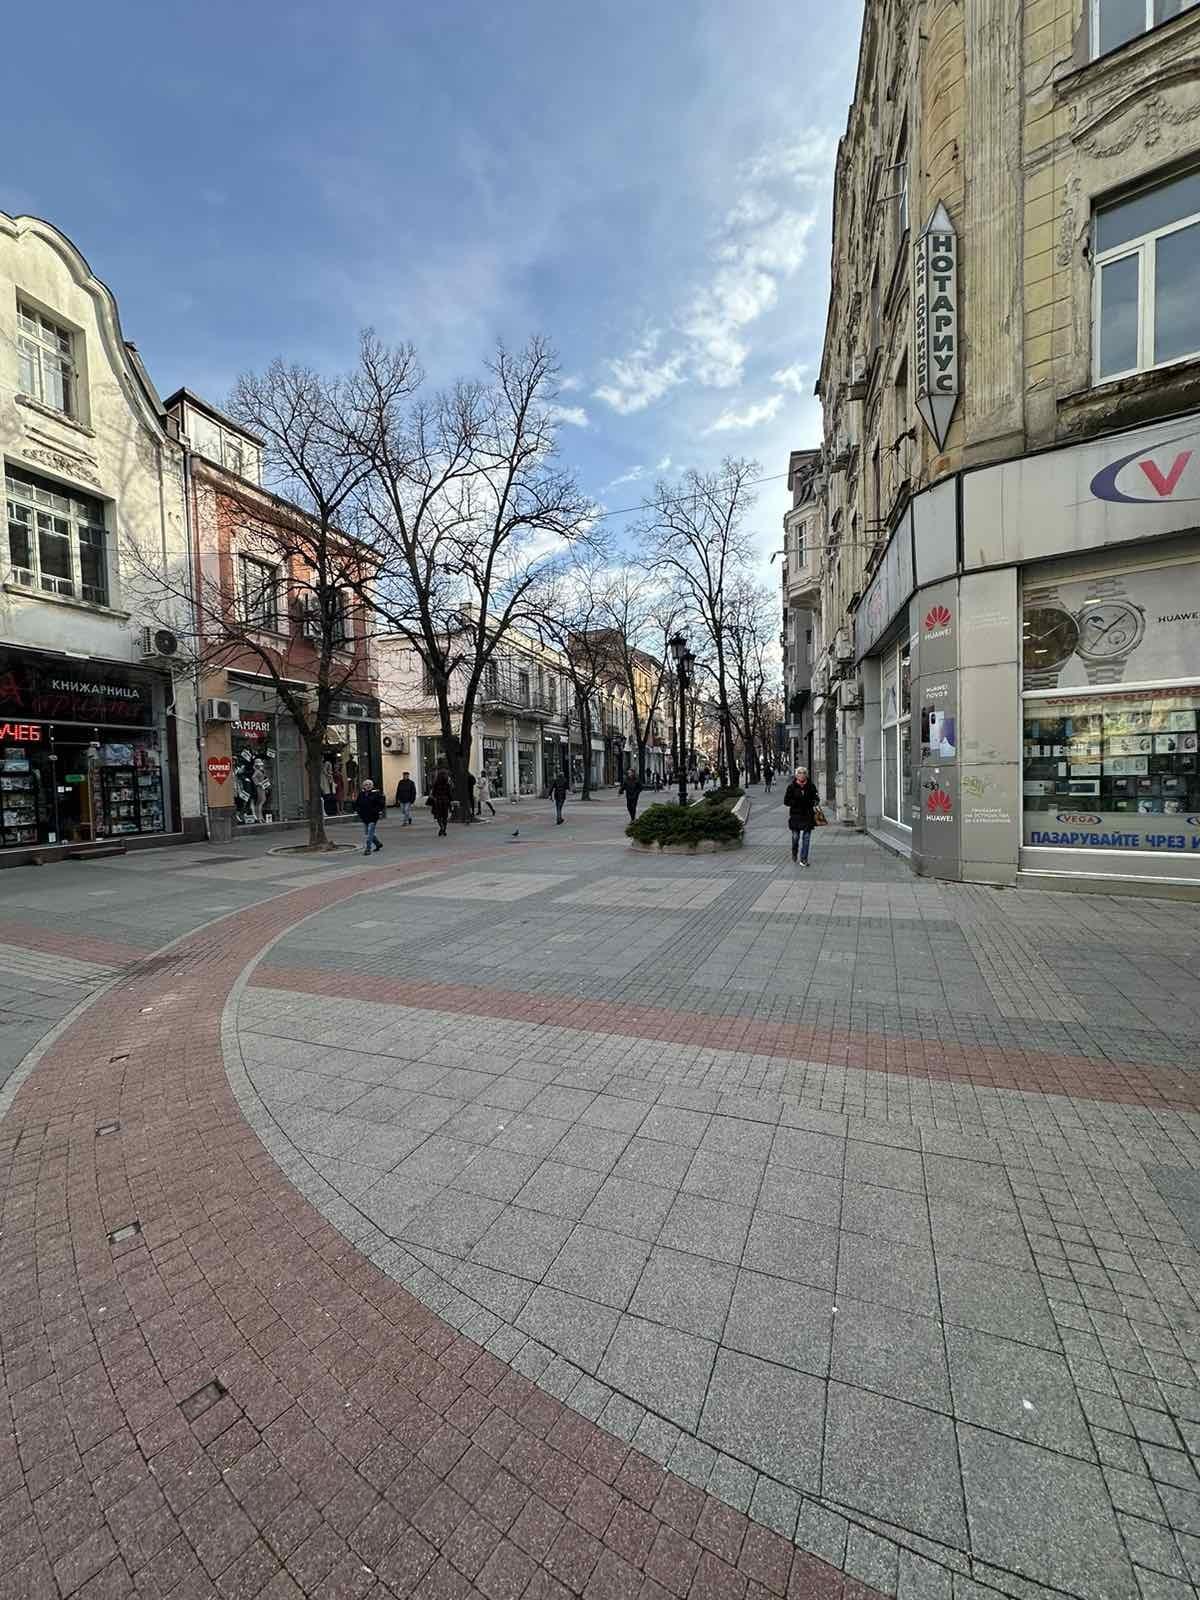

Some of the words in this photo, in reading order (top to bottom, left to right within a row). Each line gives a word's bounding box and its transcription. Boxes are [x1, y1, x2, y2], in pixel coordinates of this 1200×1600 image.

[930, 235, 954, 392] НОТАРИУС
[925, 627, 952, 640] HUAWEI
[52, 679, 140, 699] КНИЖАРНИЦА
[1031, 831, 1139, 847] ПАЗАРУВАЙТЕ
[1145, 834, 1186, 849] ЧРЕЗ
